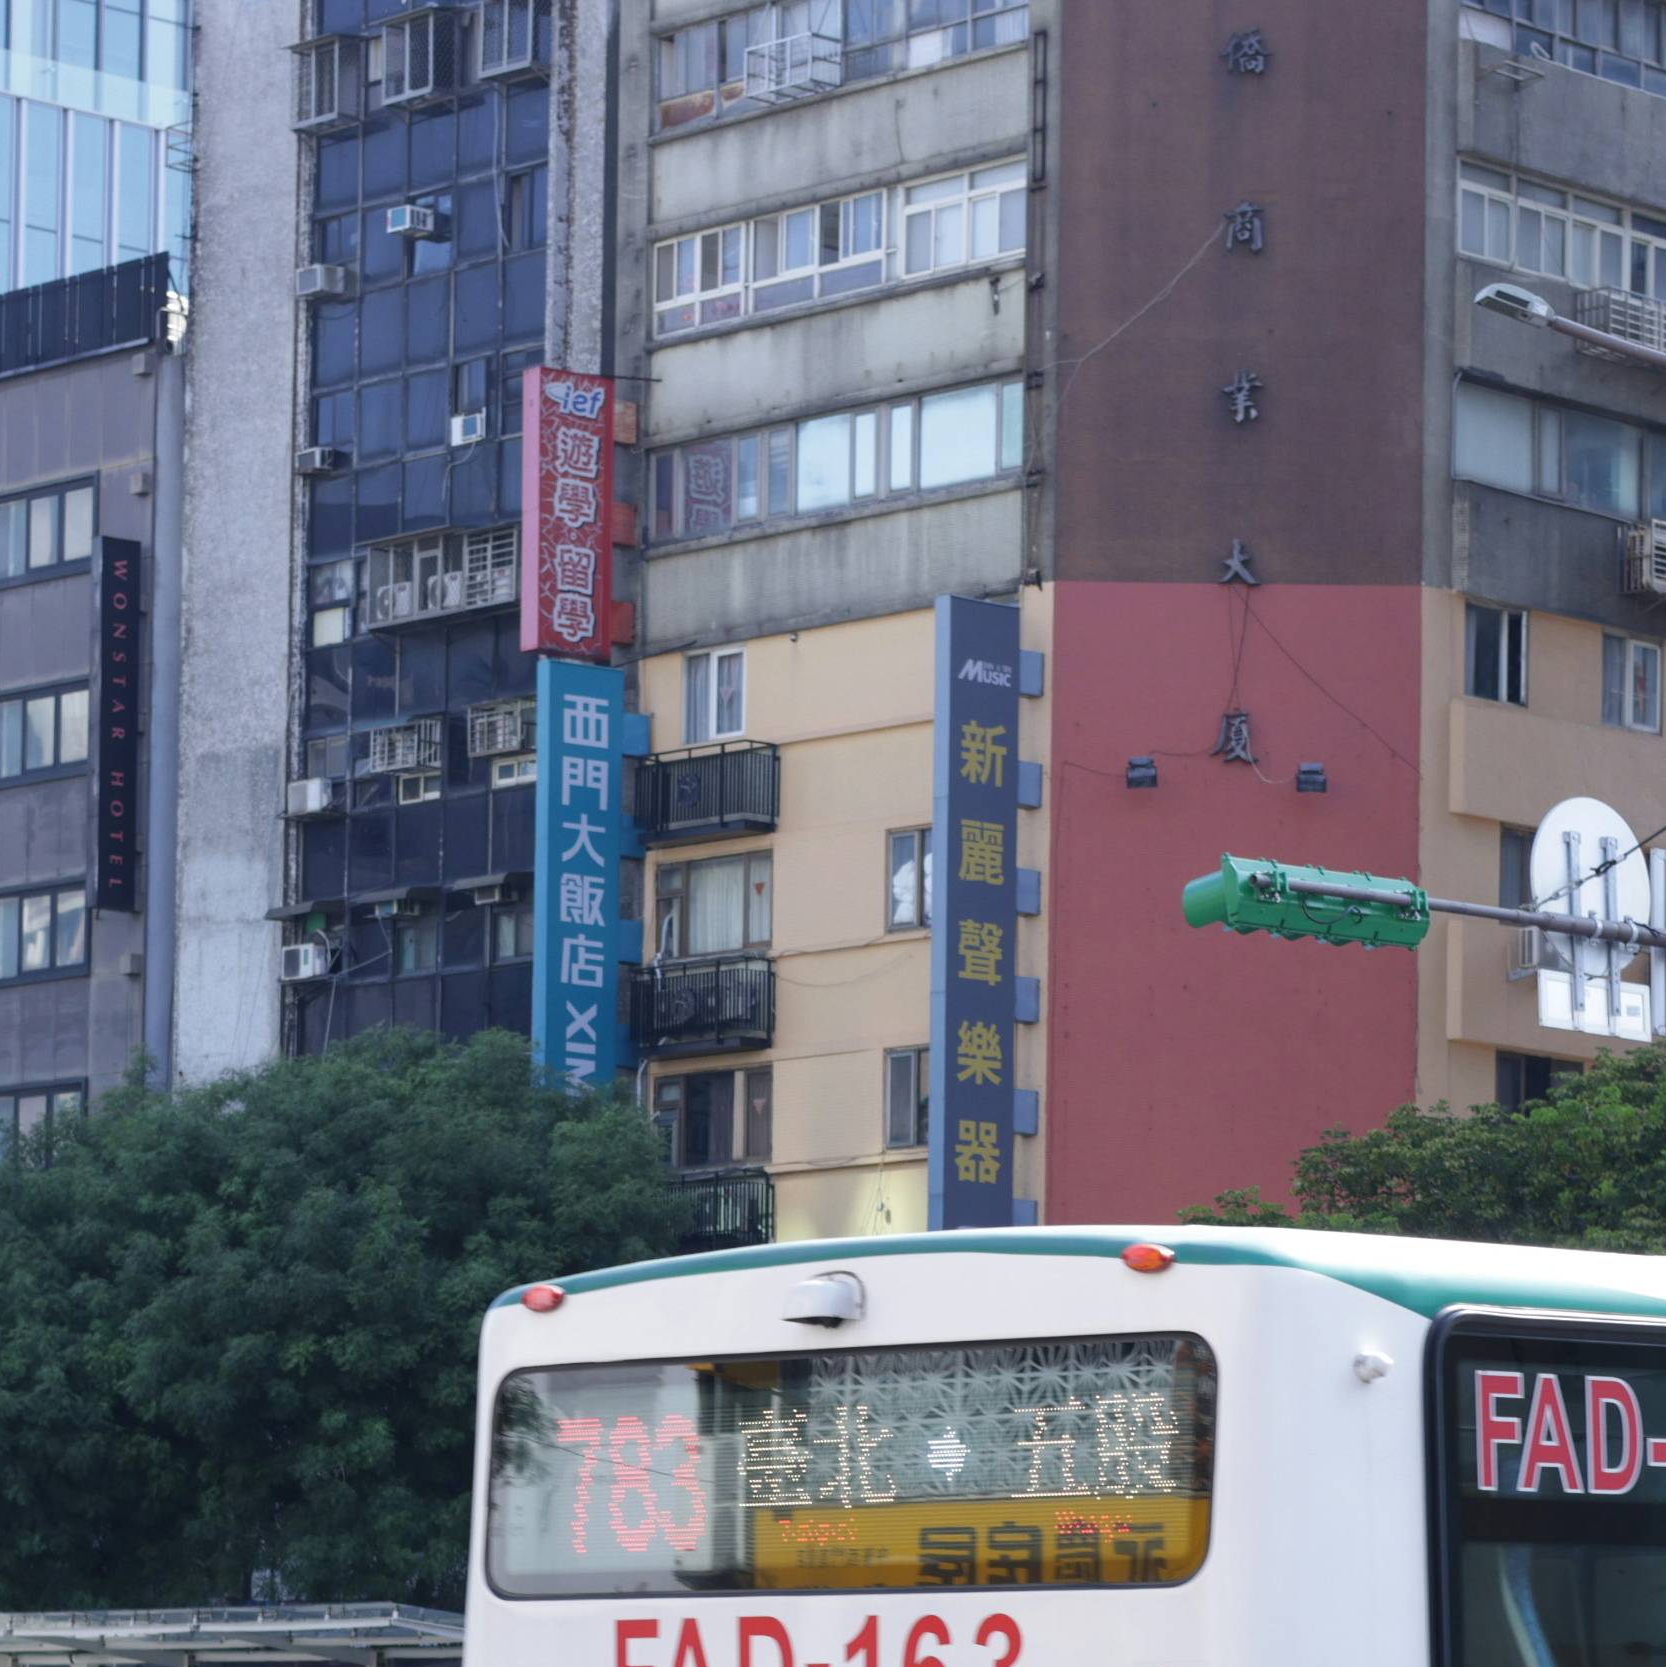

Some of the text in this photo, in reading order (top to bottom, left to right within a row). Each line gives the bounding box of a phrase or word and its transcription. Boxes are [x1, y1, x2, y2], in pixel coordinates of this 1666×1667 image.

[109, 559, 128, 888] WONSTAR HOTEL
[559, 694, 609, 988] 西門大飯店
[954, 720, 1007, 1184] 新麗聲樂器
[557, 1415, 707, 1553] 783
